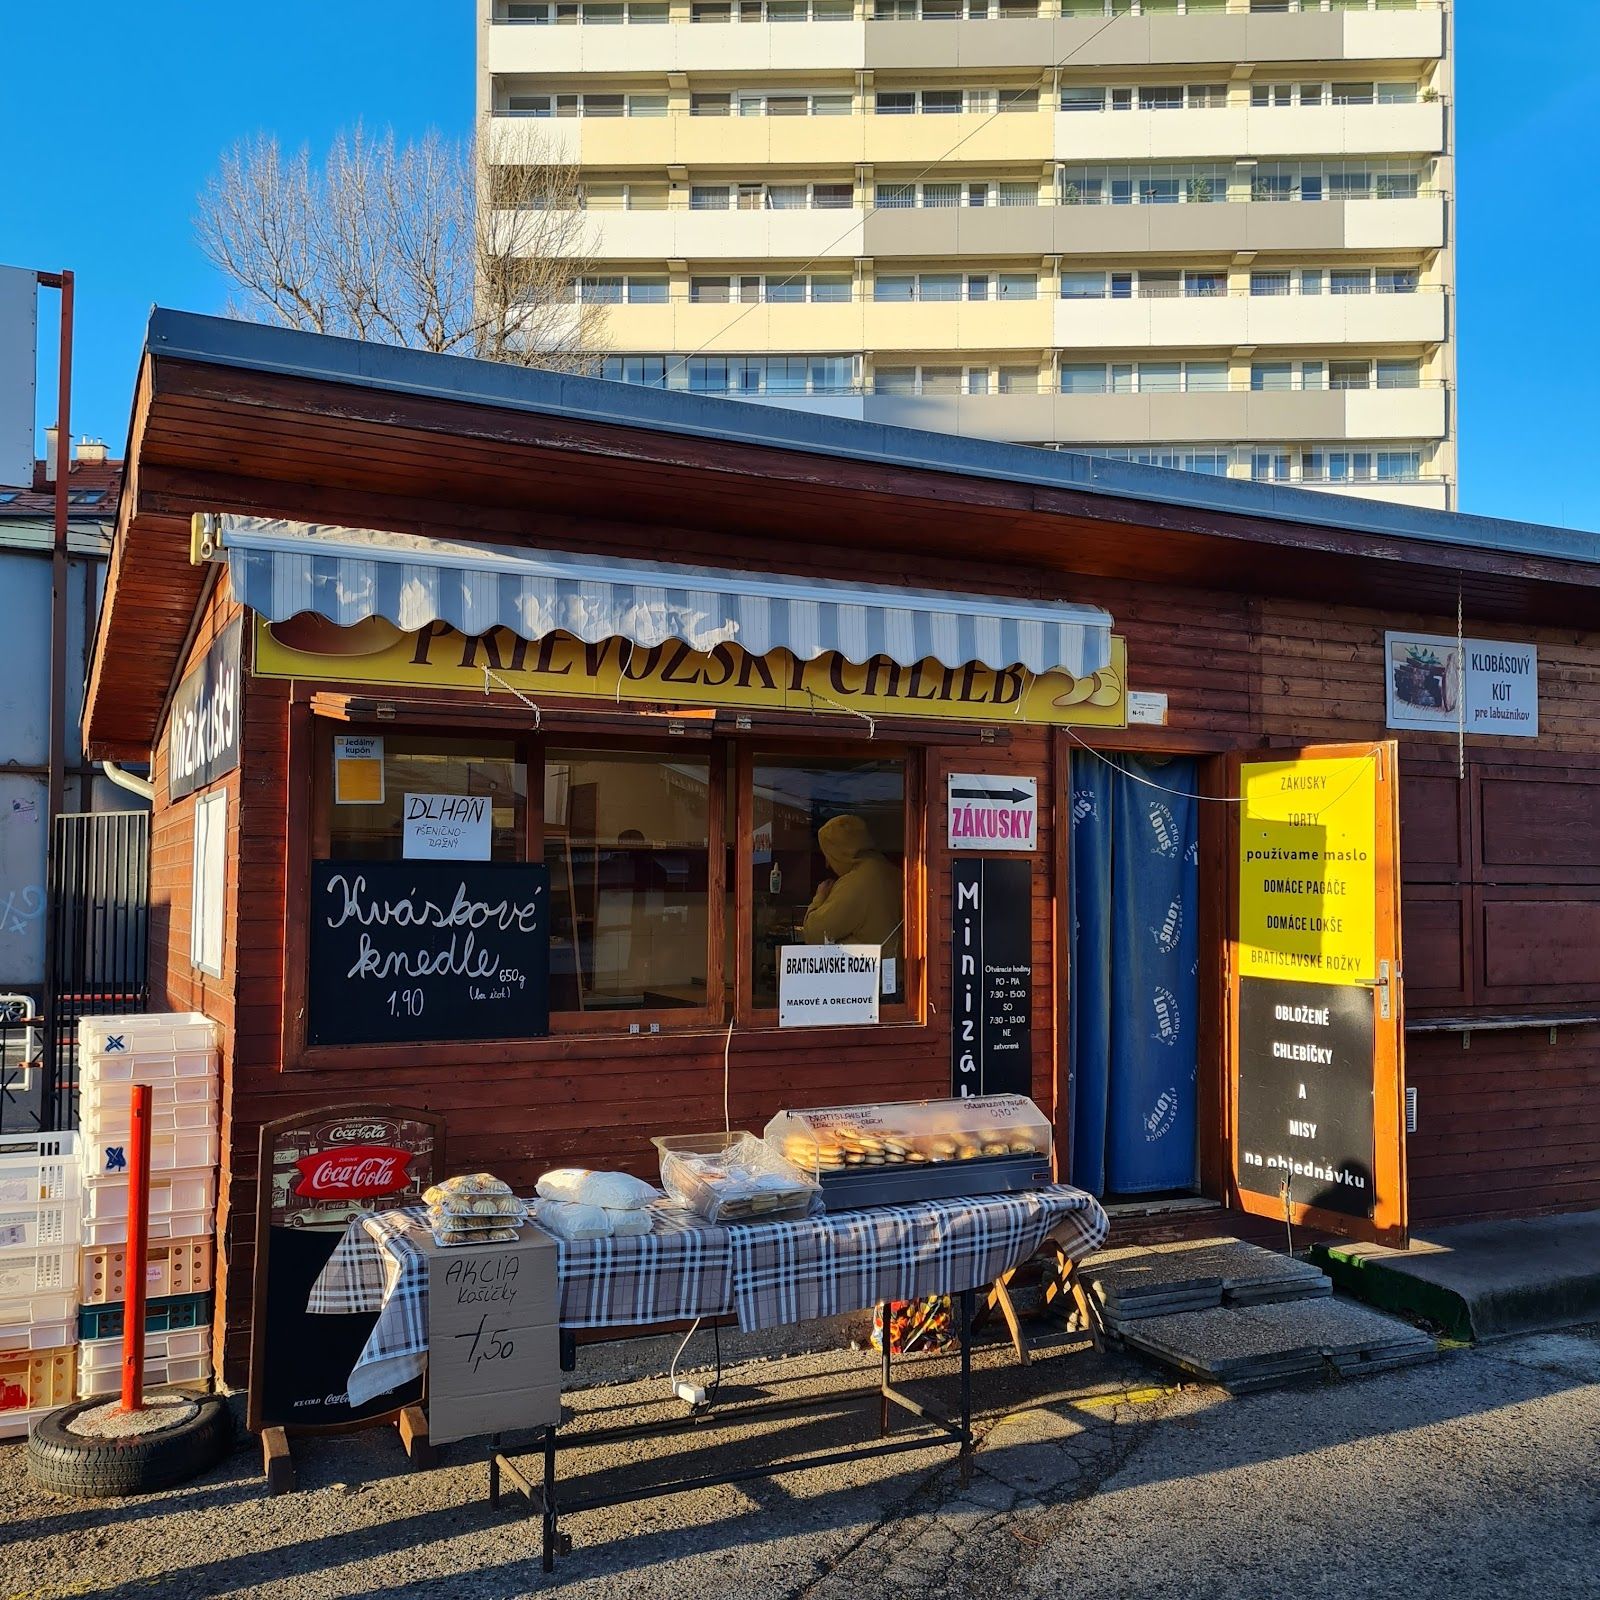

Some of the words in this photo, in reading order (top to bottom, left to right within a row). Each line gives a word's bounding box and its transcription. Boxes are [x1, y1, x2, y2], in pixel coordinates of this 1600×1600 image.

[1472, 653, 1530, 675] KLOBÁSOVÝ
[1492, 680, 1511, 701] KÚT
[1474, 708, 1488, 721] pre
[345, 738, 374, 747] Jedálny
[346, 746, 370, 755] kupón
[1281, 774, 1327, 790] ZÁKUSKY
[952, 803, 1033, 838] ZÁKUSKY
[1288, 812, 1319, 827] TORTY
[1149, 810, 1172, 850] LOTUS
[1150, 802, 1174, 822] FINEST
[1168, 823, 1180, 858] CHOICE
[1246, 848, 1319, 862] používame
[1324, 848, 1367, 861] maslo
[1264, 877, 1304, 894] DOMÁCE
[1306, 878, 1346, 896] PAGÁČE
[327, 874, 542, 932] Kváskové
[1160, 902, 1179, 942] LOTUS
[1267, 914, 1306, 930] DOMÁCE
[1310, 916, 1344, 932] LOKŠE
[348, 930, 500, 980] knedle
[786, 954, 846, 974] BRATISLAVSKÉ
[848, 953, 878, 973] ROŽKY
[1250, 949, 1322, 969] BRATISLAVSKÉ
[1326, 953, 1361, 972] ROŽKY
[1012, 965, 1030, 976] hodiny
[996, 978, 1005, 986] PO
[387, 988, 424, 1018] 1,90
[786, 997, 820, 1006] MAKOVÉ
[830, 996, 873, 1004] ORECHOVÉ
[1154, 996, 1172, 1038] LOTUS
[1155, 986, 1178, 1010] FINEST
[1168, 1012, 1180, 1046] CHOICE
[1275, 1005, 1330, 1026] OBLOŽENÉ
[1002, 1028, 1012, 1036] NE
[1273, 1042, 1333, 1064] CHLEBÍČKY
[1298, 1083, 1307, 1100] A
[1148, 1092, 1172, 1132] LOTUS
[1146, 1123, 1170, 1142] CHOICE
[1289, 1120, 1318, 1139] MISY
[1245, 1152, 1262, 1166] na
[446, 1256, 520, 1285] AKCIA
[304, 1398, 321, 1406] COLD
